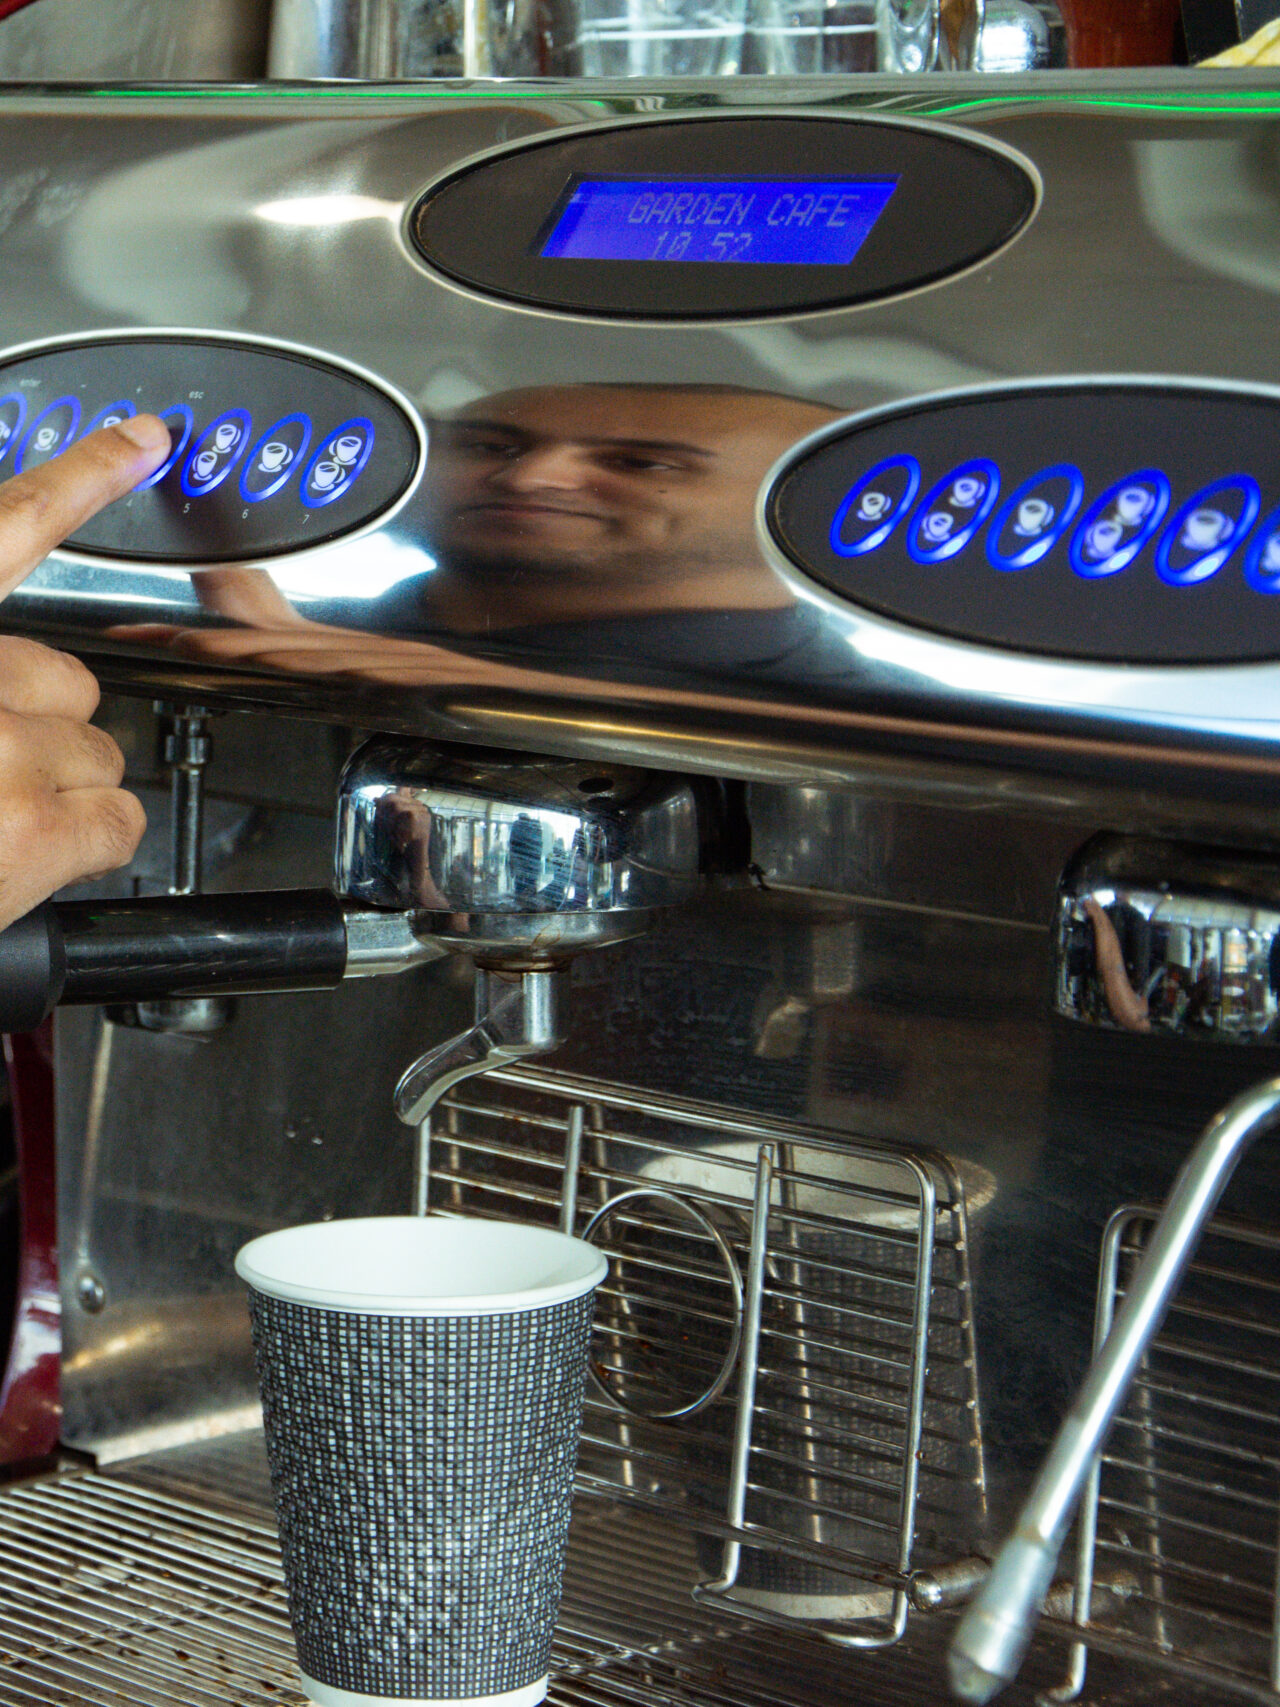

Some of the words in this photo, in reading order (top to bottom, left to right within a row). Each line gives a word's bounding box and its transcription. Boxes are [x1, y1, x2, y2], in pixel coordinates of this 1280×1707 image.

[628, 192, 756, 225] GARDEN
[766, 193, 860, 227] CAFE
[183, 502, 191, 513] 5
[241, 508, 249, 519] 6
[302, 513, 310, 524] 7
